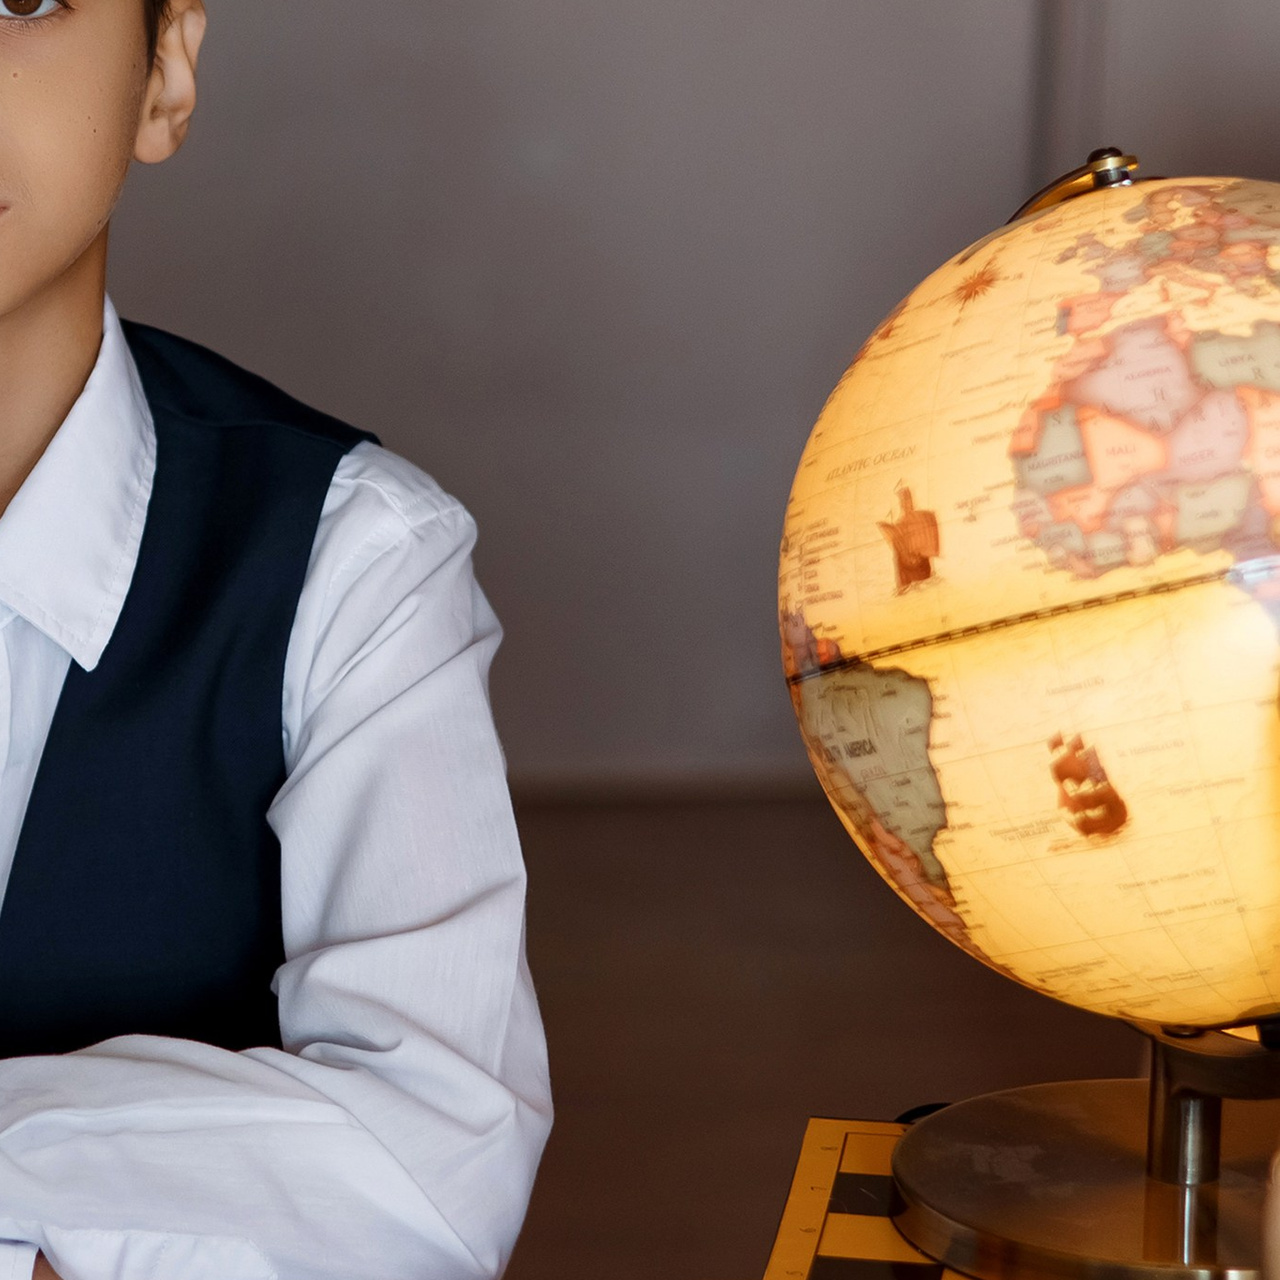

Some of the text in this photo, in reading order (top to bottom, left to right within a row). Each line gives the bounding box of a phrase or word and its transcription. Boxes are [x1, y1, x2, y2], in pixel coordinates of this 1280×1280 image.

[1219, 353, 1255, 367] LIBYA
[1123, 366, 1172, 381] ALGERIA
[824, 445, 916, 482] ATLANTIC OCEAN
